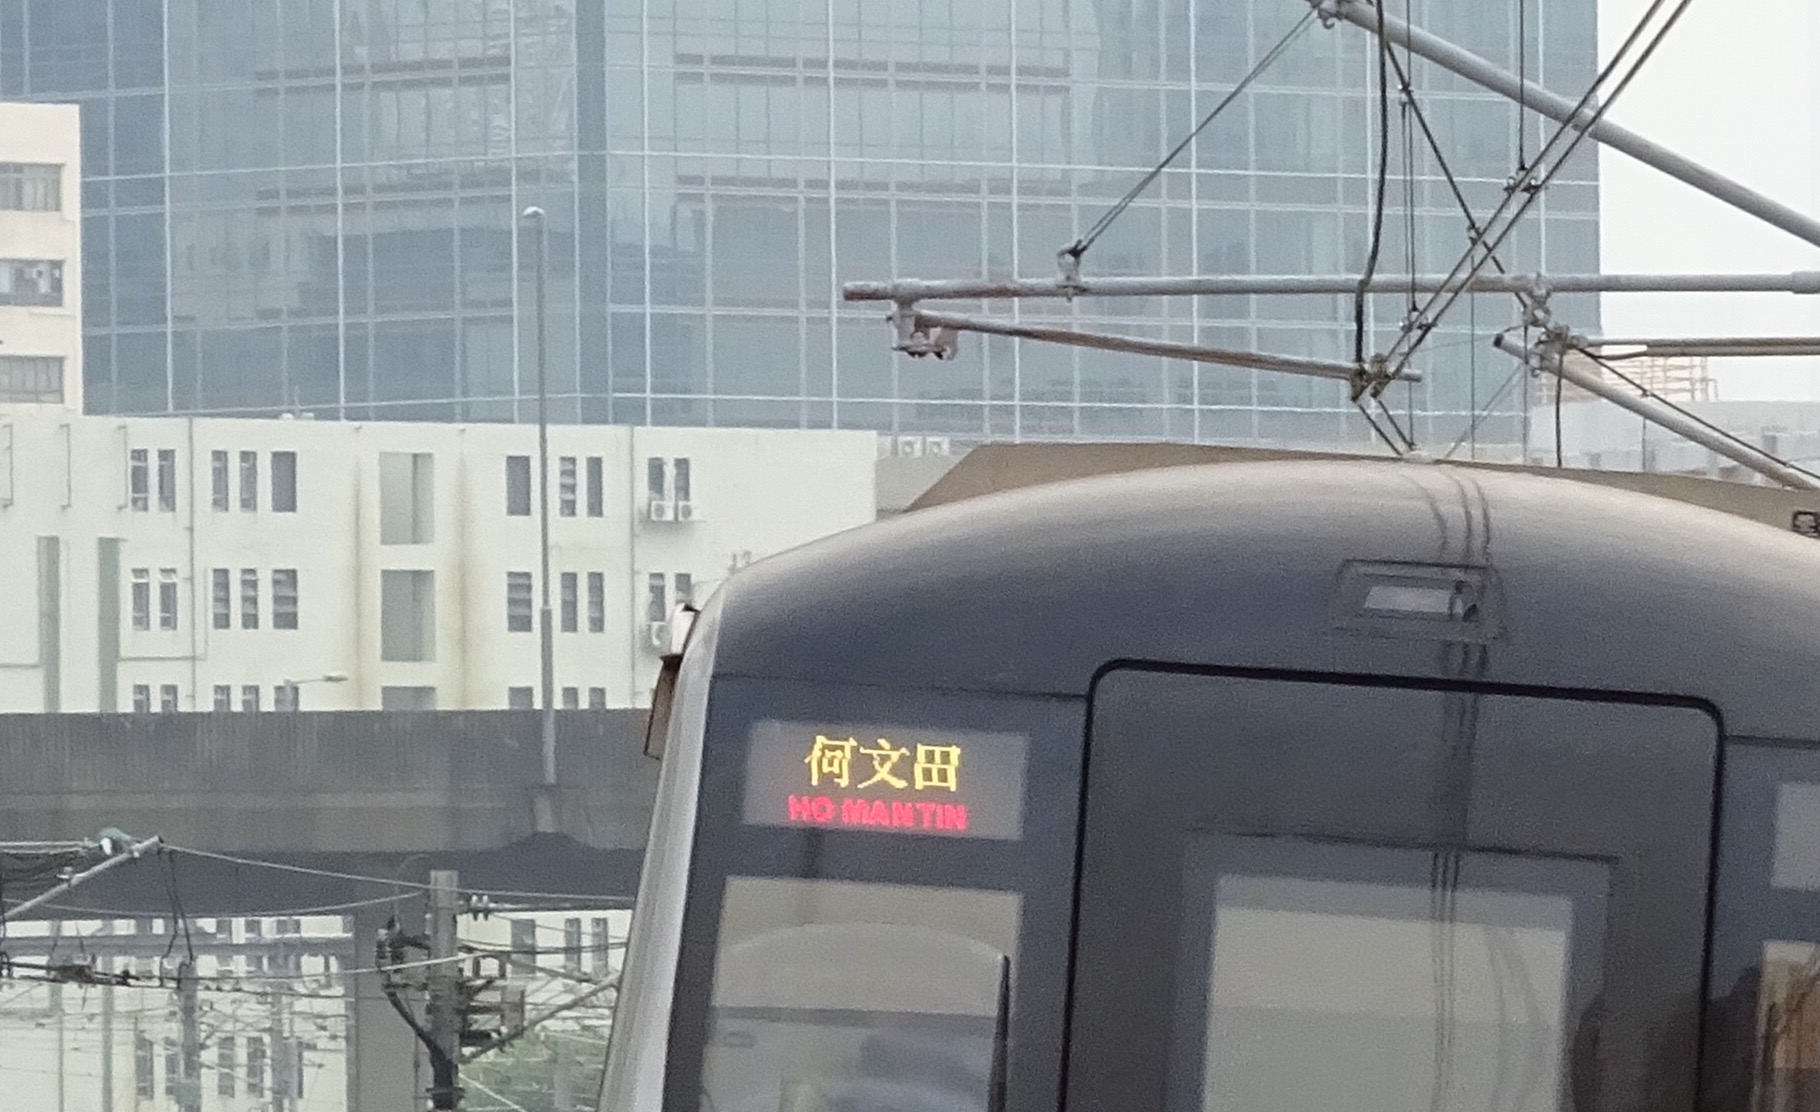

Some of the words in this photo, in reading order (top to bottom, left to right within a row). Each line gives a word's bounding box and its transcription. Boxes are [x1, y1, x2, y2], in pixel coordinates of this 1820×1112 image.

[804, 735, 961, 792] 何文田
[787, 794, 835, 822] HO
[841, 799, 914, 827] MAN
[915, 803, 968, 831] TIN
